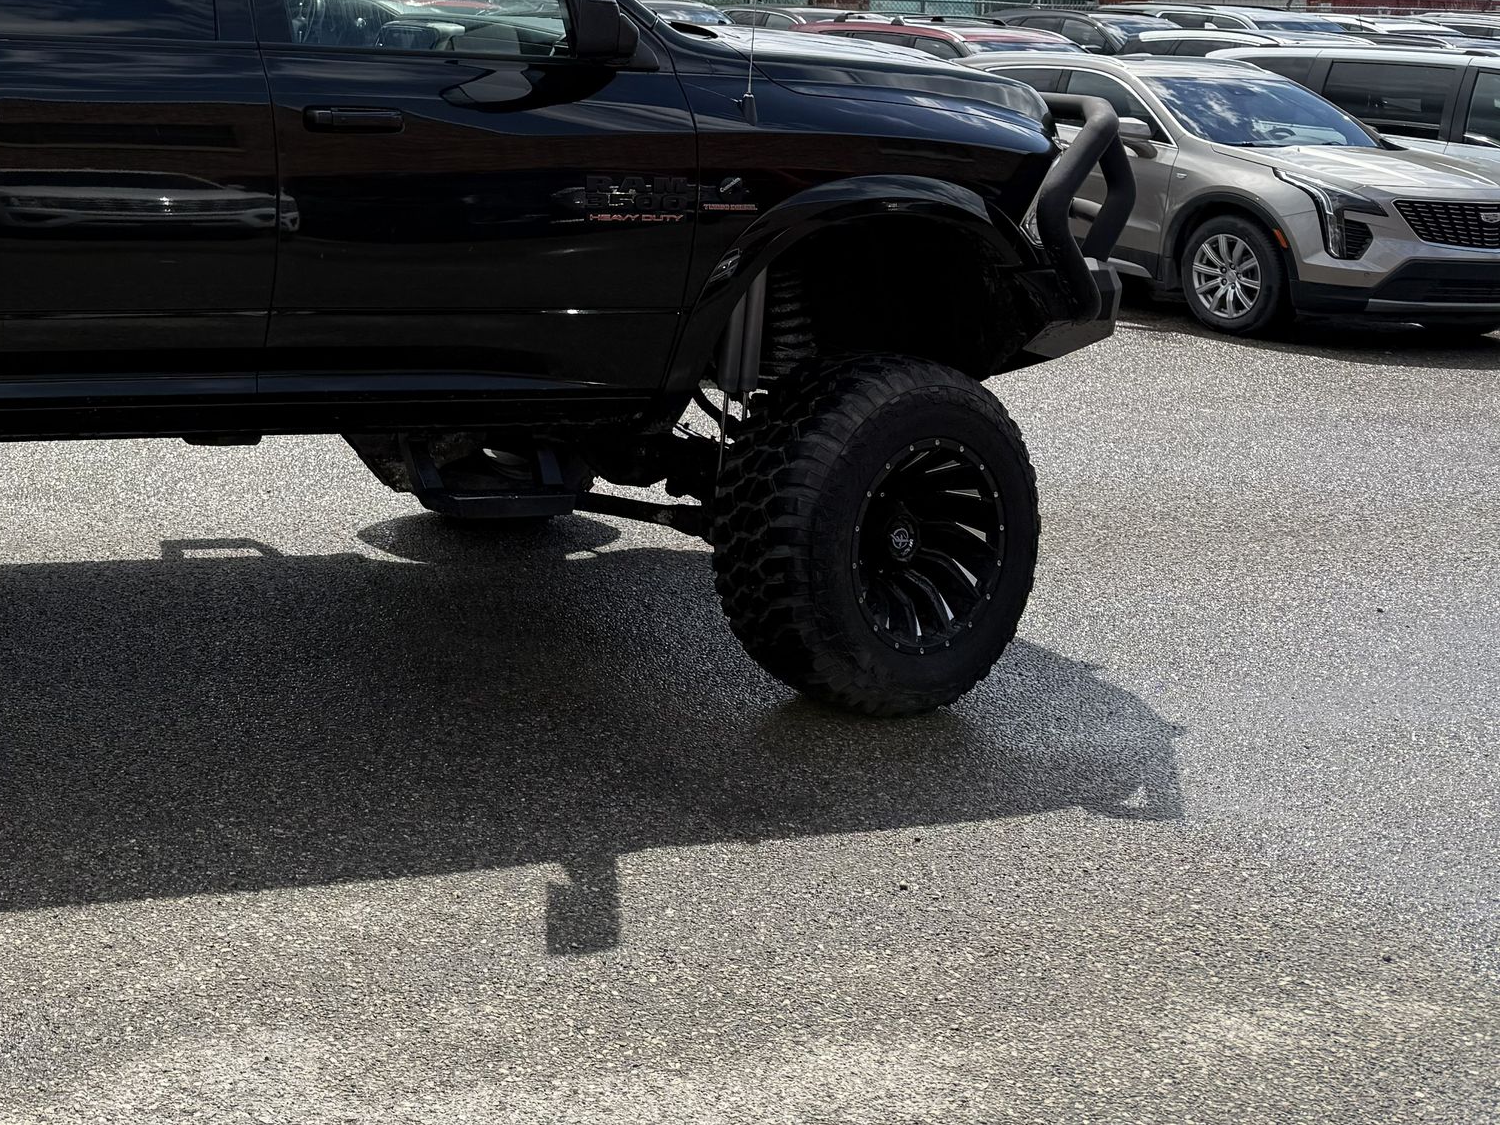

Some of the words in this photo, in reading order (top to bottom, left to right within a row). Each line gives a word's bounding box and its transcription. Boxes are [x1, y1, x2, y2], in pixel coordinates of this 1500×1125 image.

[586, 176, 688, 194] RAM
[590, 214, 640, 222] HEAVY
[641, 214, 684, 222] DUTY
